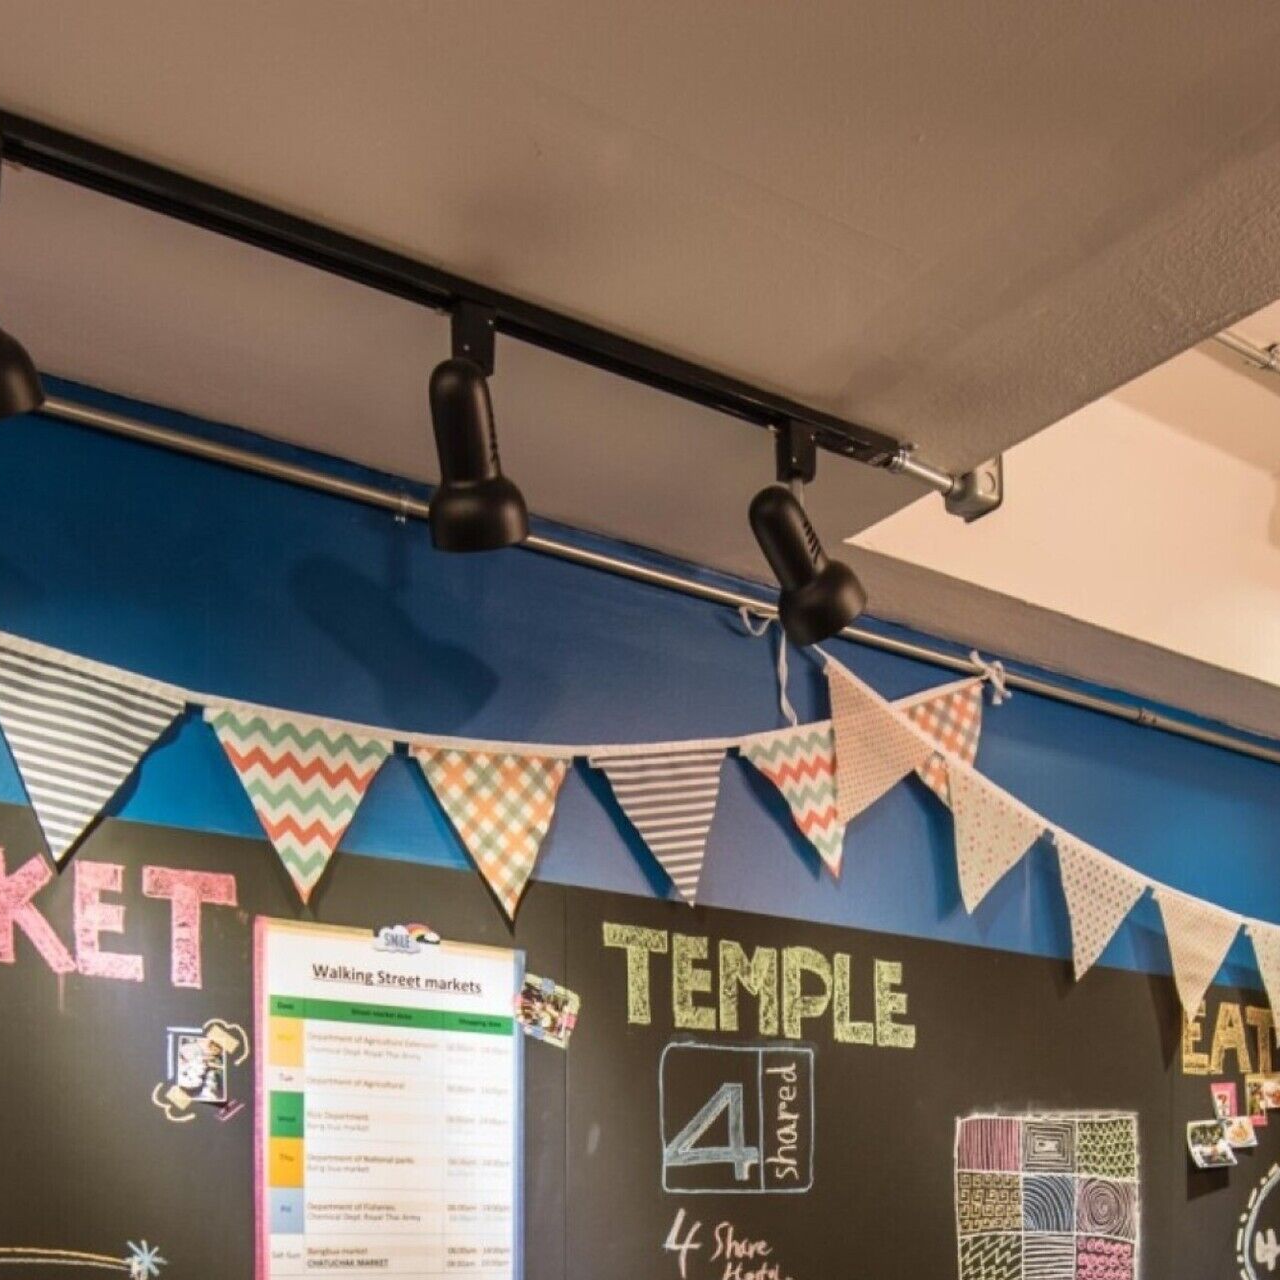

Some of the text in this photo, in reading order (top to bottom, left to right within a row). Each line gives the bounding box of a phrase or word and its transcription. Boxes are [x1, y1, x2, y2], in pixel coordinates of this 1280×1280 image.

[312, 963, 483, 993] Walking Street markets
[602, 921, 916, 1049] TEMPLE
[1180, 999, 1275, 1075] EAT
[663, 1083, 760, 1181] 4
[766, 1061, 800, 1180] shared
[662, 1208, 703, 1280] 4
